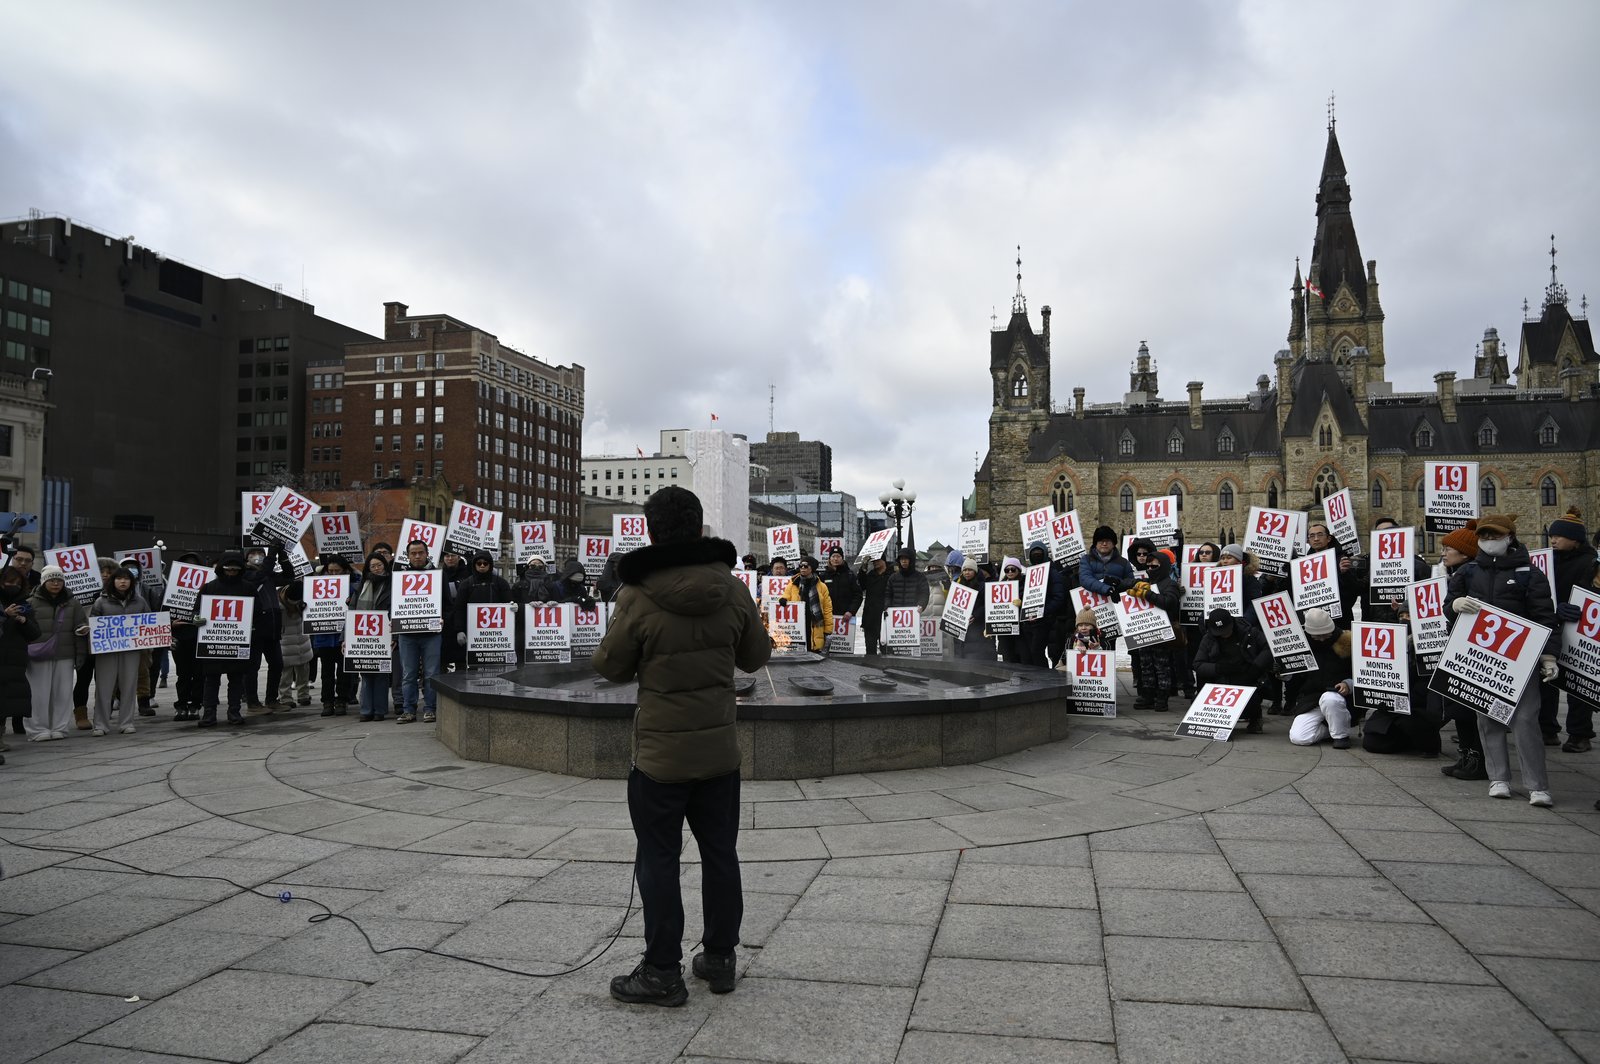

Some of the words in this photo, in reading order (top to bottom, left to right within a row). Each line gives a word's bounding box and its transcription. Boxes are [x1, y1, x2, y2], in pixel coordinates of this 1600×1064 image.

[1439, 466, 1463, 491] 19
[281, 494, 309, 520] 23
[1146, 500, 1165, 519] 41
[1330, 495, 1345, 521] 30
[324, 516, 346, 534] 31
[461, 506, 481, 528] 13
[623, 518, 641, 535] 38
[1030, 512, 1045, 529] 19
[1259, 512, 1285, 536] 32
[411, 524, 432, 545] 39
[523, 525, 543, 544] 22
[775, 528, 790, 545] 27
[962, 526, 976, 537] 29
[1054, 516, 1072, 539] 34
[588, 539, 606, 556] 31
[1249, 540, 1274, 550] WAITING
[1256, 535, 1280, 544] MONTHS
[1381, 532, 1401, 559] 31
[59, 550, 86, 573] 39
[1258, 549, 1287, 559] RESPONSE
[179, 567, 205, 590] 40
[1030, 567, 1043, 587] 30
[1302, 556, 1324, 583] 37
[316, 579, 337, 599] 35
[405, 574, 428, 595] 22
[1213, 570, 1231, 593] 24
[1304, 581, 1325, 591] MONTHS
[953, 587, 969, 608] 38
[994, 584, 1009, 603] 30
[1299, 589, 1321, 600] WAITING
[1308, 593, 1335, 604] RESPONSE
[1416, 584, 1439, 619] 34
[215, 599, 238, 621] 11
[480, 607, 502, 628] 34
[538, 607, 557, 627] 11
[895, 610, 910, 627] 20
[1130, 611, 1153, 620] MONTHS
[1263, 598, 1289, 627] 53
[97, 616, 126, 628] STOP
[131, 614, 156, 625] THE
[358, 614, 379, 635] 43
[1126, 618, 1150, 627] WAITING
[1137, 620, 1166, 630] RESPONSE
[1421, 620, 1439, 630] MONTHS
[1272, 636, 1291, 645] WAITING
[1273, 627, 1292, 636] MONTHS
[1418, 631, 1437, 640] WAITING
[1475, 613, 1524, 656] 37
[1282, 641, 1305, 652] RESPONSE
[1364, 628, 1391, 658] 42
[1080, 654, 1102, 676] 14
[1366, 661, 1392, 669] MONTHS
[1453, 652, 1495, 676] WAITING
[1494, 670, 1514, 684] FOR
[1467, 647, 1508, 670] MONTHS
[1560, 653, 1578, 668] IRCC
[1360, 668, 1386, 678] WAITING
[1444, 659, 1465, 674] IRCC
[1464, 668, 1516, 697] RESPONSE
[1565, 671, 1575, 680] NO
[1356, 677, 1369, 685] IRCC
[1370, 678, 1404, 689] RESPONSE
[1447, 677, 1459, 687] NO
[1458, 682, 1494, 702] TIMELINE
[1447, 685, 1459, 695] NO
[1566, 681, 1575, 690] NO
[1206, 687, 1240, 707] 36
[1370, 692, 1394, 700] TIMELINE
